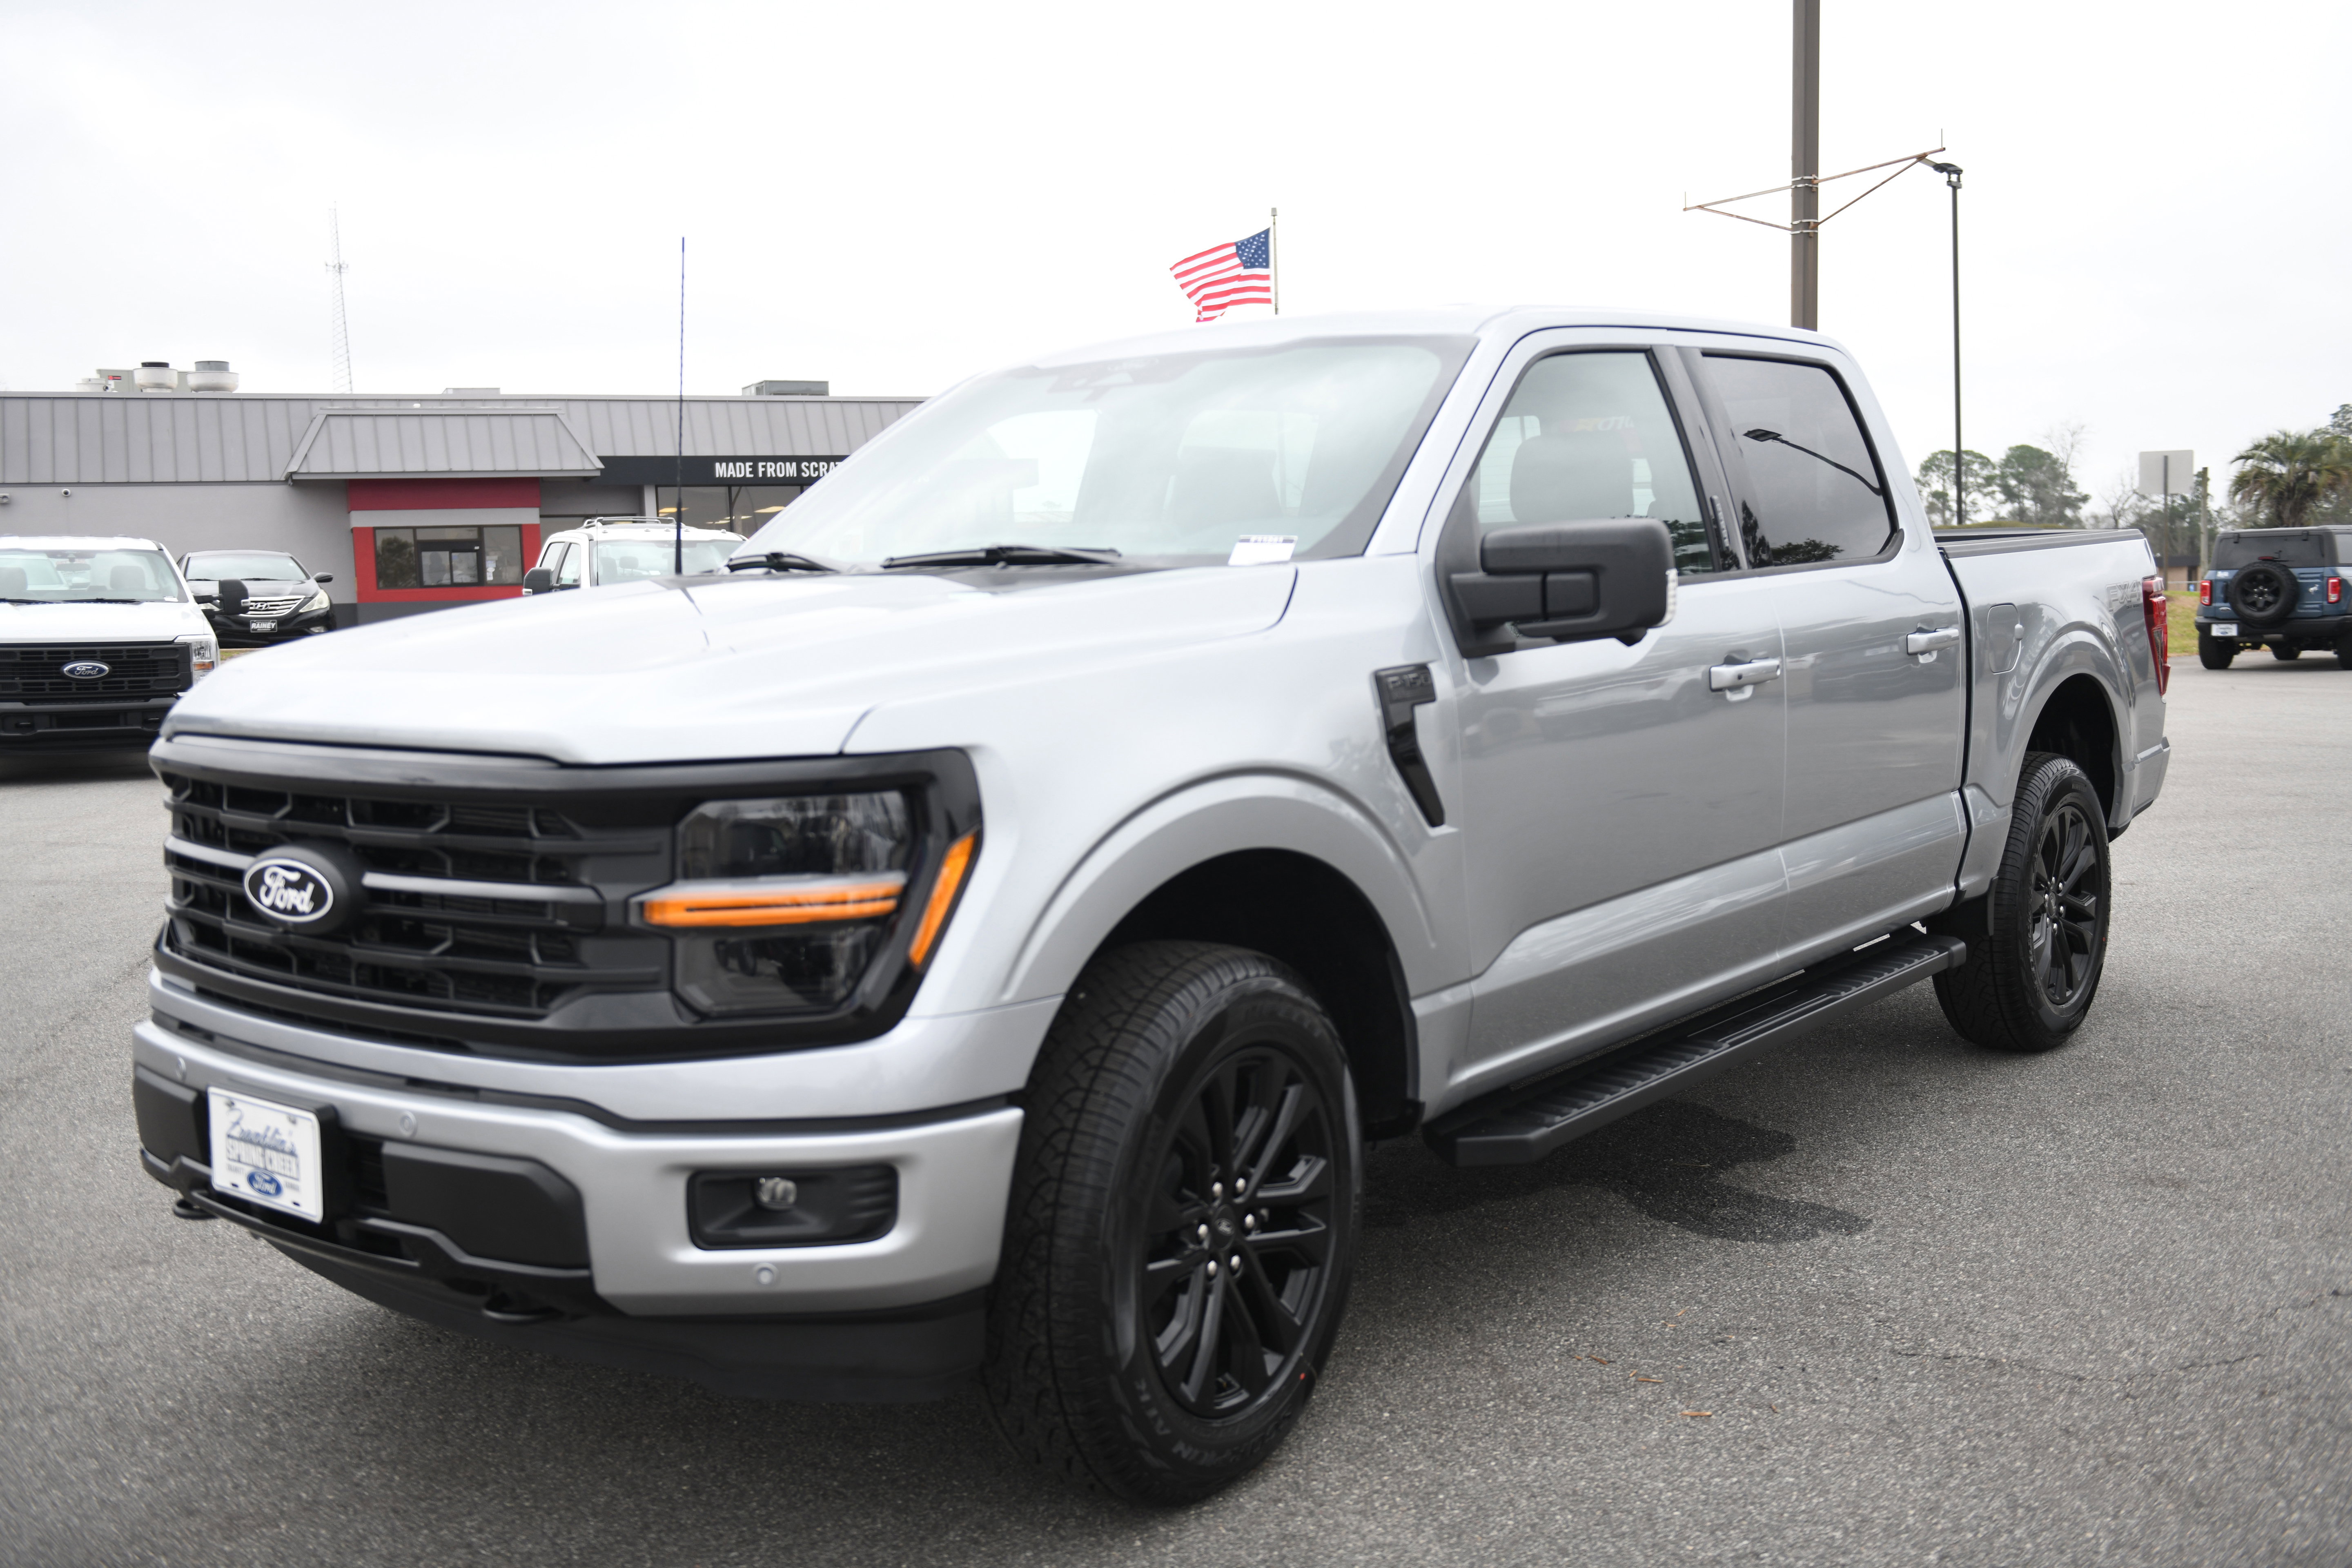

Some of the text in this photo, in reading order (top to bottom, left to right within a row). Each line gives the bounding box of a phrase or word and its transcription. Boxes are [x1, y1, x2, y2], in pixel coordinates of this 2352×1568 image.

[715, 462, 754, 477] MADE
[758, 462, 797, 477] FROM
[2105, 580, 2140, 612] FX4
[75, 666, 99, 675] Ford
[1387, 673, 1432, 689] F-150
[260, 866, 315, 913] Ford
[253, 1172, 277, 1194] Ford
